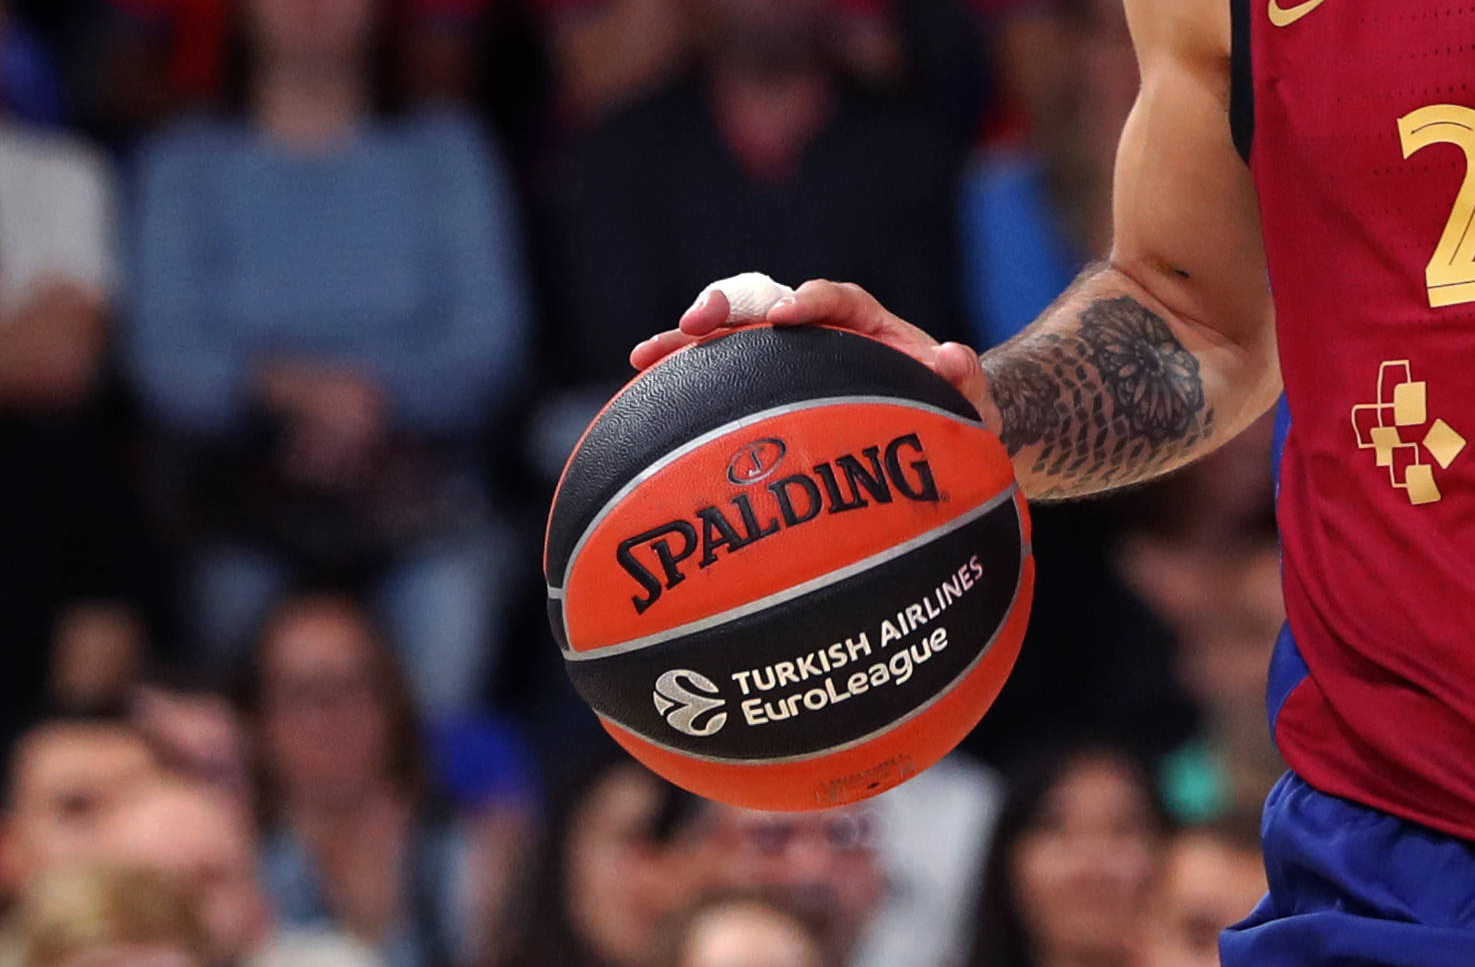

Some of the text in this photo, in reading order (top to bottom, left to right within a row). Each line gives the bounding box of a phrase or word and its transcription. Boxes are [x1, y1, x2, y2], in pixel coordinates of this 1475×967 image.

[616, 433, 939, 615] SPALDING
[732, 554, 984, 695] TURKISH AIRLINES
[741, 627, 948, 726] EuroLeague
